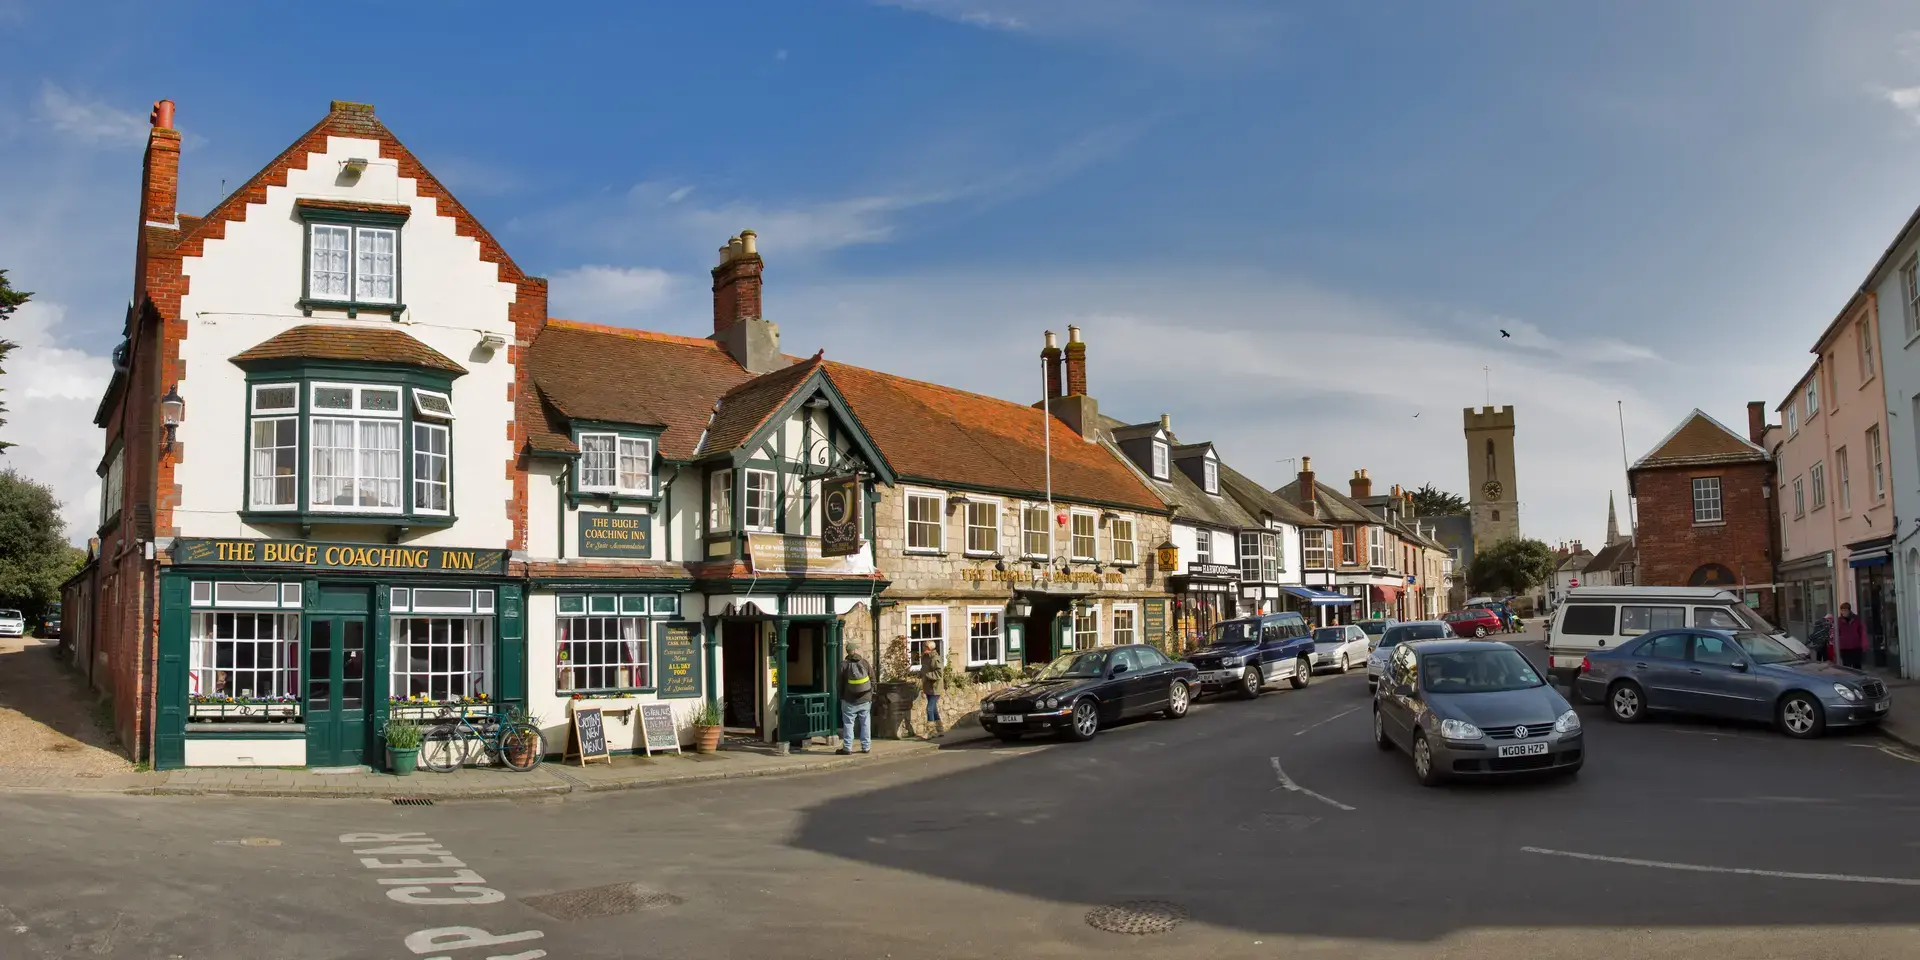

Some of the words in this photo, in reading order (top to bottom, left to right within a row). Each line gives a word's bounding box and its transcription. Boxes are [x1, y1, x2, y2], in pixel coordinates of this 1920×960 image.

[592, 518, 608, 528] THE
[612, 519, 638, 528] BUGLE
[585, 529, 628, 539] COACHING
[632, 531, 645, 540] INN
[216, 542, 255, 561] THE
[263, 543, 318, 565] BUGE
[325, 546, 429, 568] COACHING
[441, 552, 475, 569] INN
[960, 568, 984, 582] THE
[991, 569, 1032, 582] BUGLE
[1106, 572, 1123, 583] INN
[1202, 564, 1228, 574] HARWOODS
[582, 738, 603, 754] MENU
[1502, 746, 1526, 756] WG08
[1528, 744, 1545, 754] HZP
[338, 832, 506, 905] CLEAR
